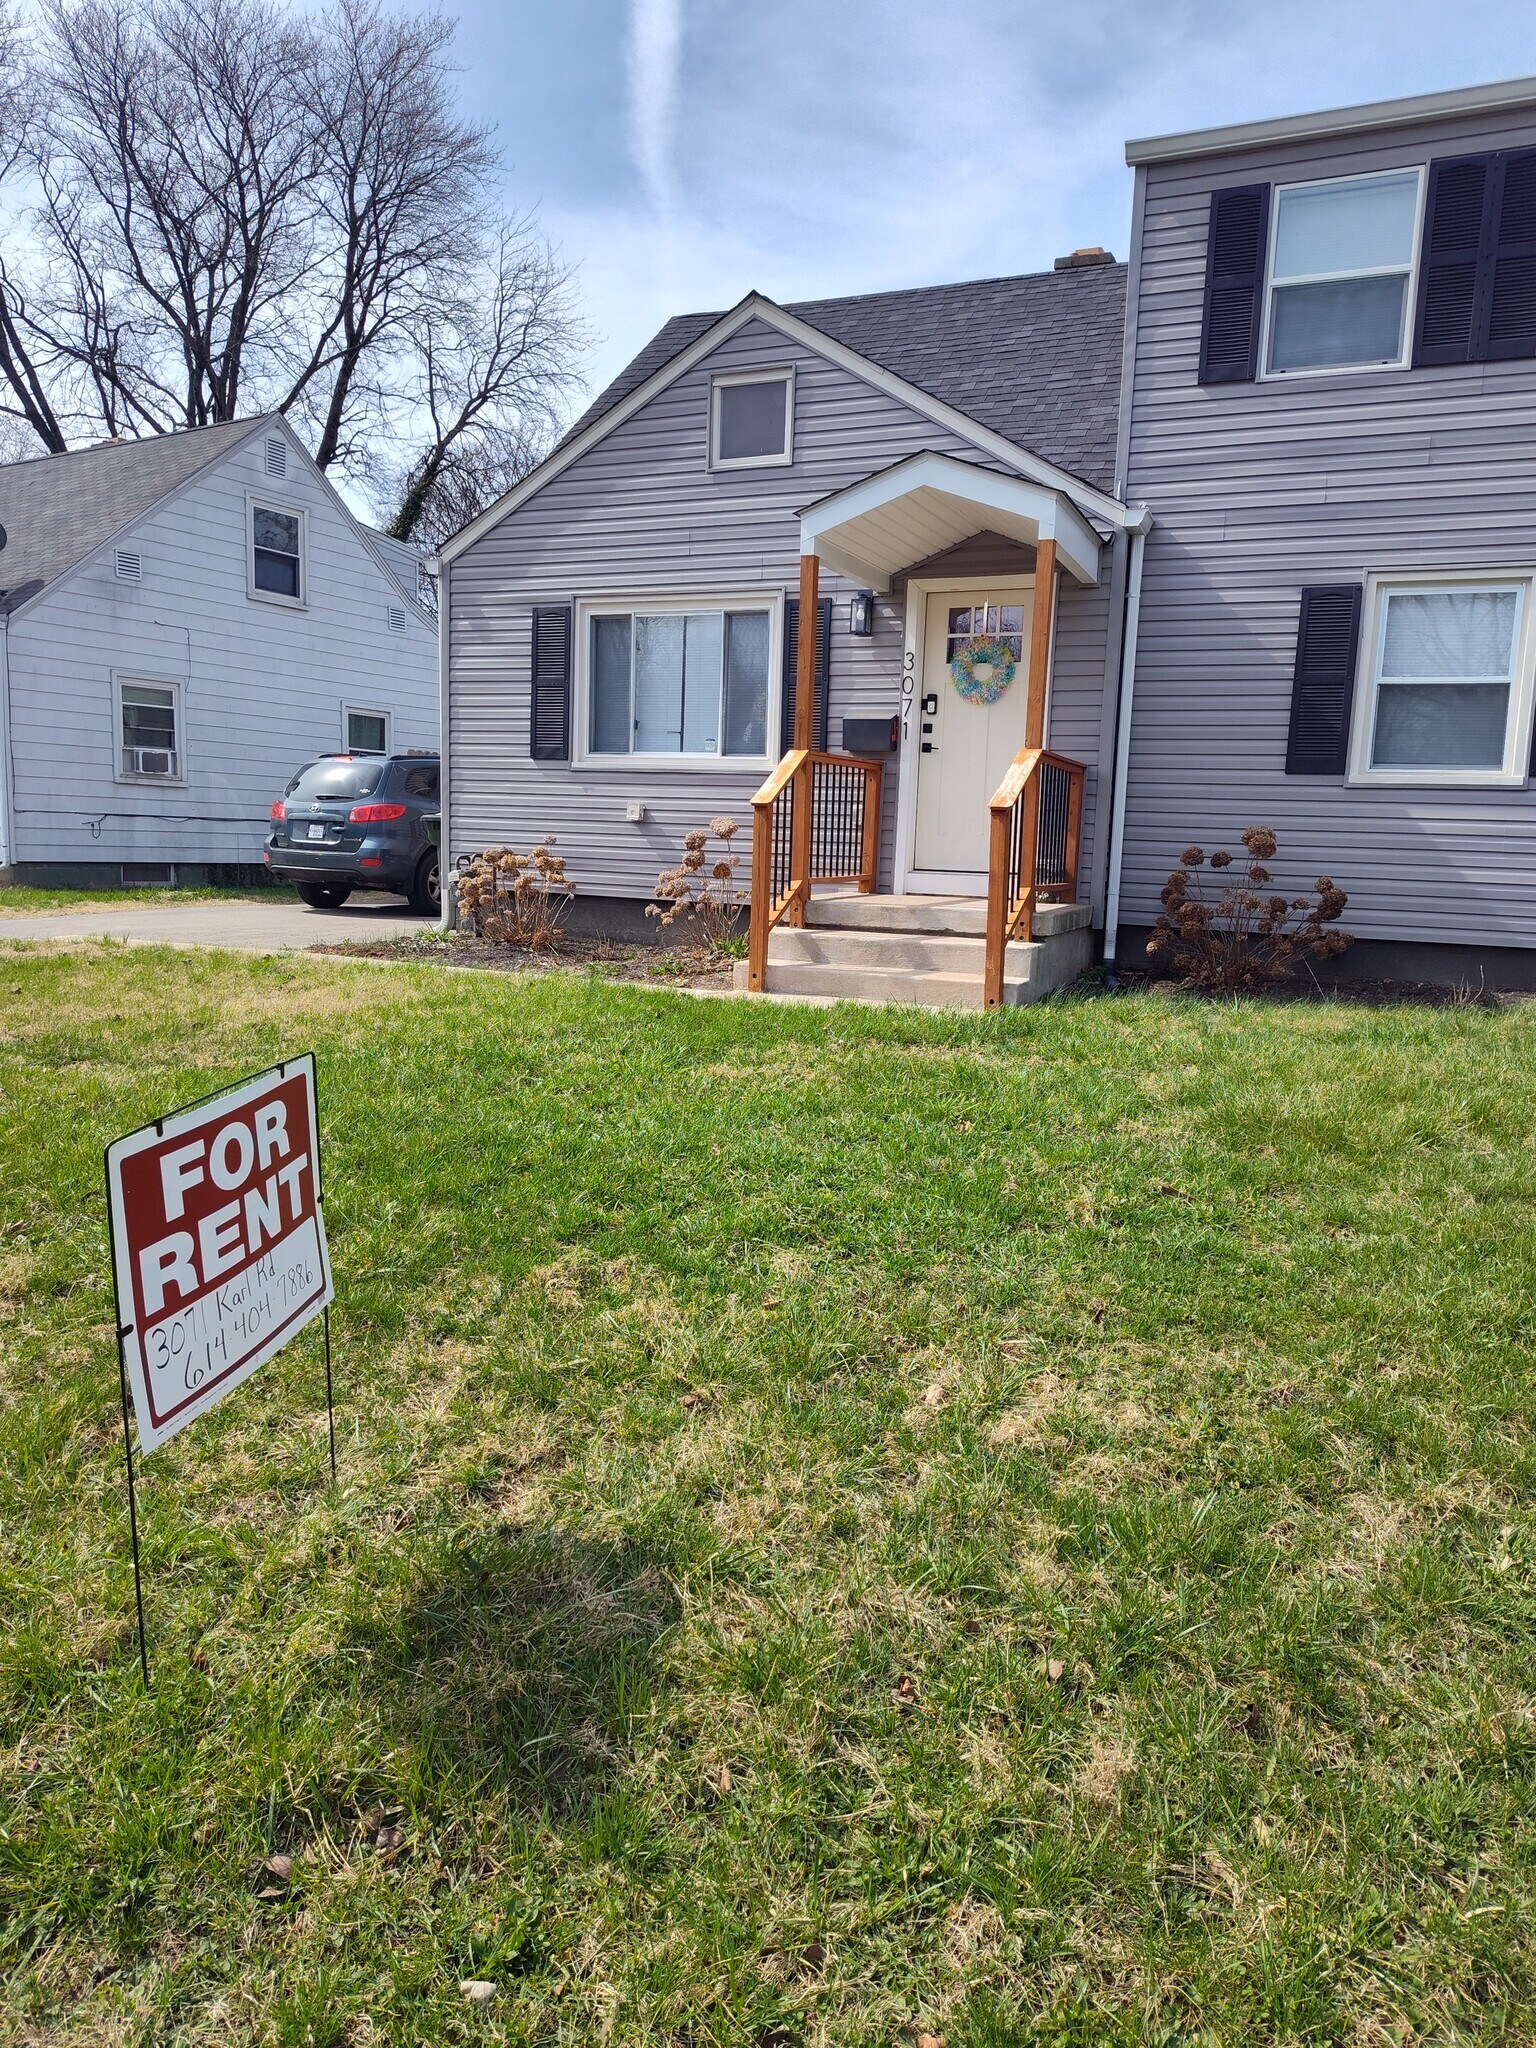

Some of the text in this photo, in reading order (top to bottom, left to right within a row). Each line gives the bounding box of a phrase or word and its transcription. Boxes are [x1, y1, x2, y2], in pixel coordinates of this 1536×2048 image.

[902, 652, 914, 740] 3071
[159, 1100, 291, 1223] FOR
[138, 1153, 309, 1318] RENT
[152, 1302, 207, 1369] 3071
[216, 1270, 252, 1322] Karl
